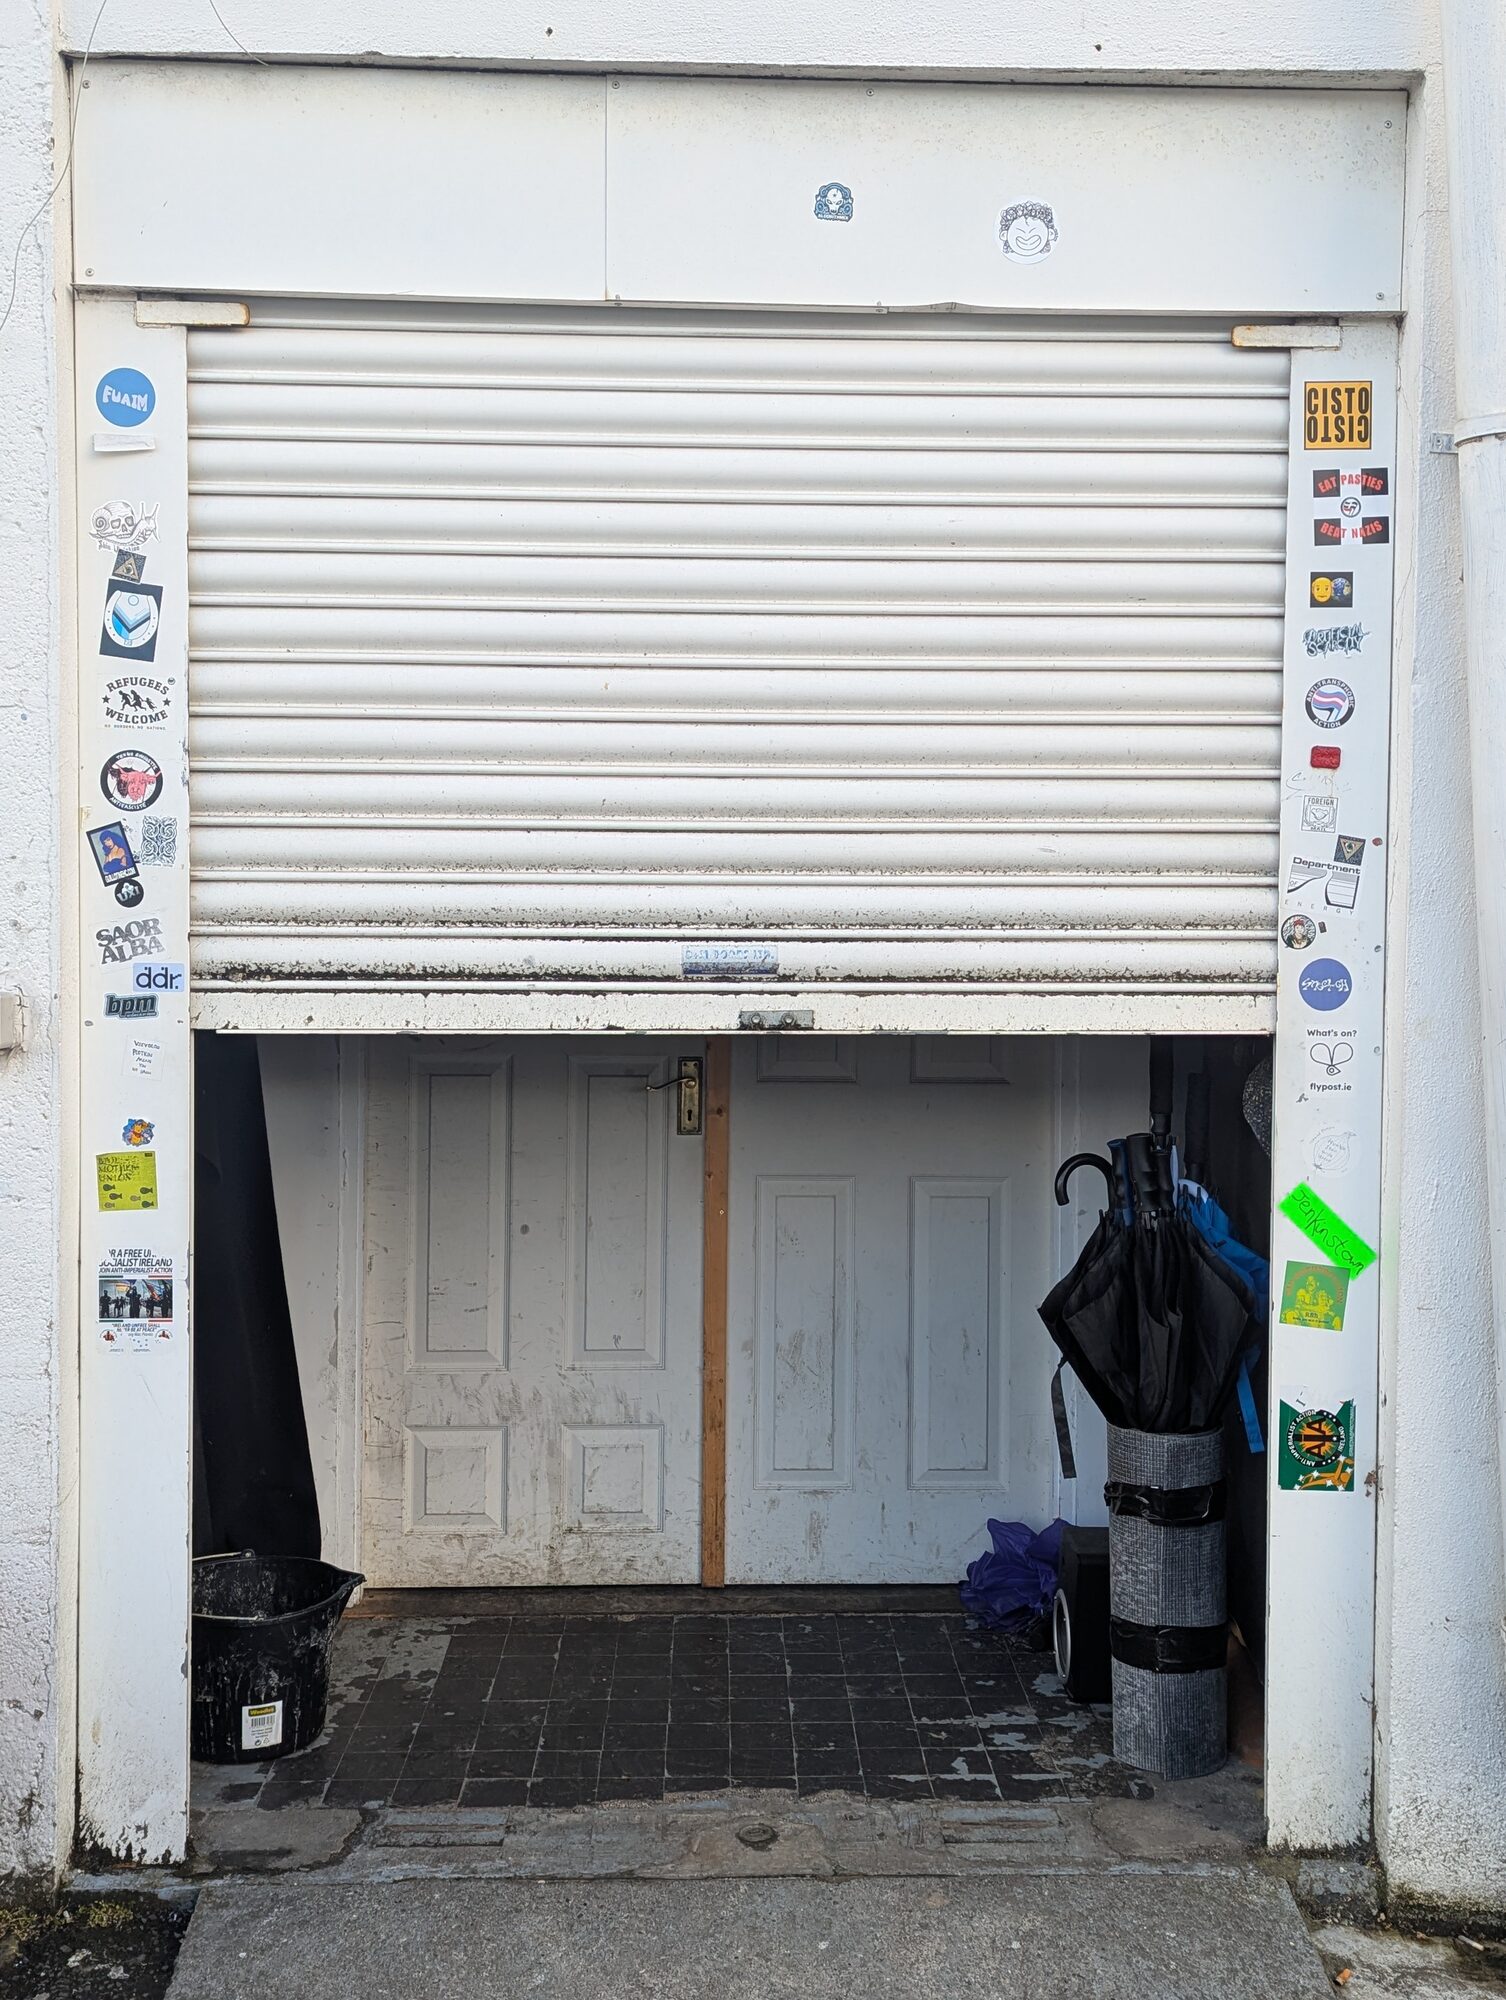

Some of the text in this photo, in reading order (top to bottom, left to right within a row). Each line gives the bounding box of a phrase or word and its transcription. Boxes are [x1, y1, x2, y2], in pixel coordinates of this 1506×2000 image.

[102, 384, 148, 412] FUAIM
[1307, 387, 1369, 414] CISTO
[1318, 474, 1383, 493] EAT PASTIES
[1320, 520, 1382, 538] BEAT NAZIS
[106, 677, 169, 695] REFUGEES
[105, 707, 168, 724] WELCOME
[1313, 718, 1341, 728] ACTION
[1307, 797, 1334, 806] FOREIGN
[1293, 857, 1361, 874] Department
[96, 918, 163, 947] SAOR
[101, 936, 165, 964] ALBA
[106, 995, 157, 1016] bpm
[1307, 1029, 1338, 1037] What's
[1310, 1082, 1352, 1092] flypost.ie
[124, 1249, 143, 1257] FREE
[139, 1258, 172, 1267] IRELAND
[1296, 1410, 1316, 1422] ACTION
[1288, 1421, 1315, 1467] ANTI-IMPERIALIST
[1337, 1425, 1345, 1452] IRELAND
